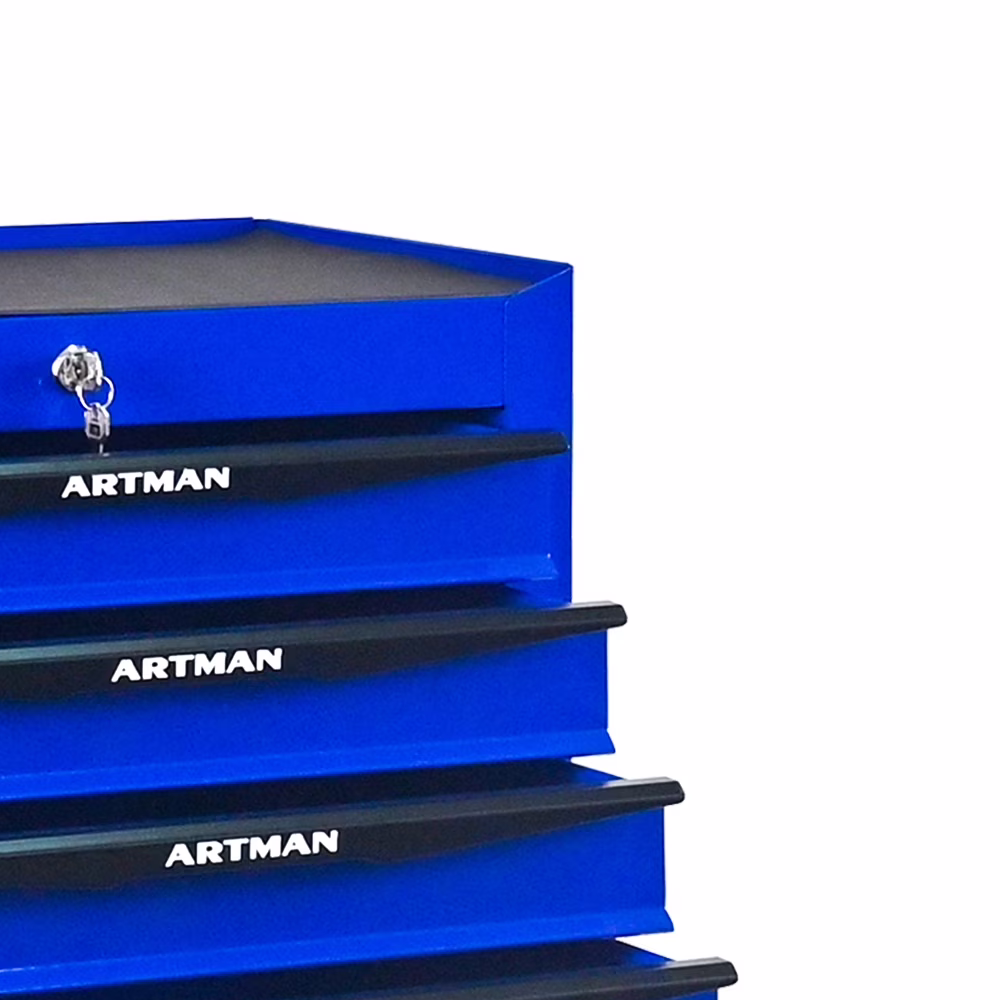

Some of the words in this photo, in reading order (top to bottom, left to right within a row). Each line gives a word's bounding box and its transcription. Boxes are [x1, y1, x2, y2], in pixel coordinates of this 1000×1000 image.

[61, 466, 230, 498] ARTMAN
[110, 647, 282, 682] ARTMAN
[164, 829, 338, 867] ARTMAN
